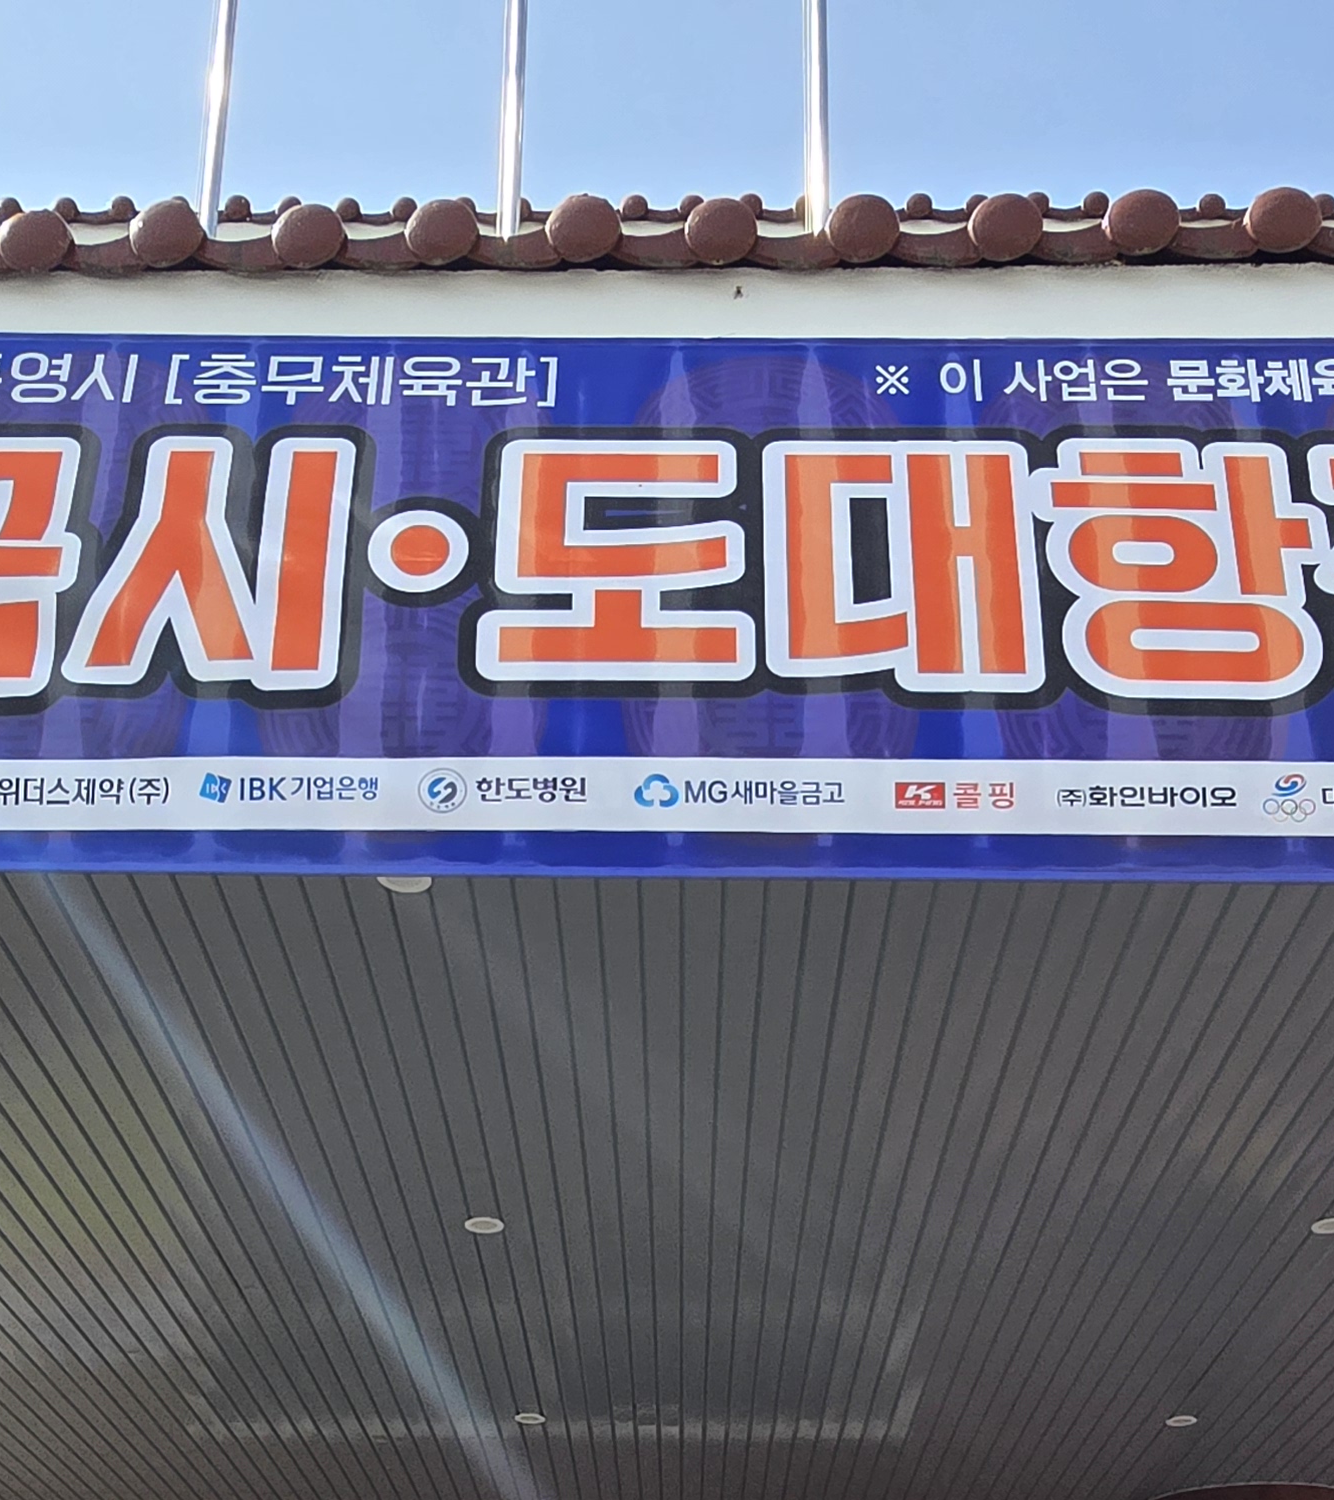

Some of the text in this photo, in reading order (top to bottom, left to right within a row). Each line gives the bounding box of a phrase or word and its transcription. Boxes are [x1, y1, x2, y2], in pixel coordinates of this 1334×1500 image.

[164, 353, 558, 406] [충무체육관]
[939, 361, 983, 402] 이
[1003, 360, 1149, 402] 사업은
[475, 777, 588, 803] 한도병원
